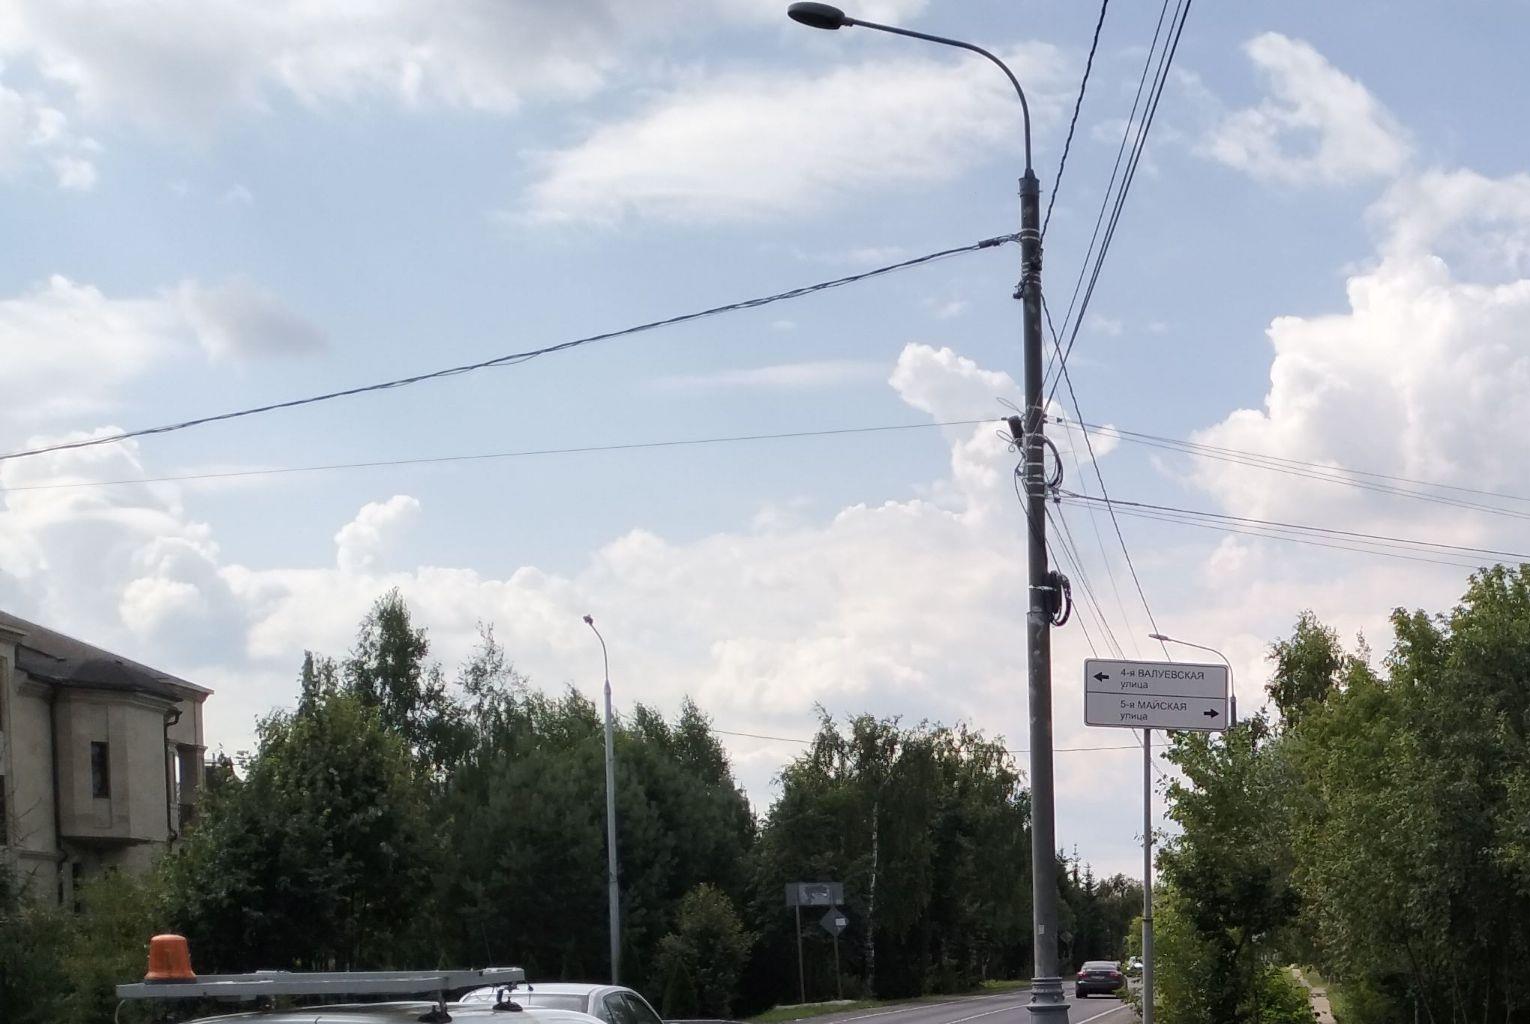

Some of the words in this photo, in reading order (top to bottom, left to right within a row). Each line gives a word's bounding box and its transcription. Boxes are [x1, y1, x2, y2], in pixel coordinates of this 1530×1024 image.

[1120, 668, 1135, 676] 4-я
[1138, 668, 1205, 680] ВАЛУЕВСКАЯ
[1120, 680, 1149, 690] улица
[1120, 699, 1135, 709] 5-я
[1138, 698, 1188, 711] МАЙСКАЯ
[1120, 712, 1149, 722] улица
